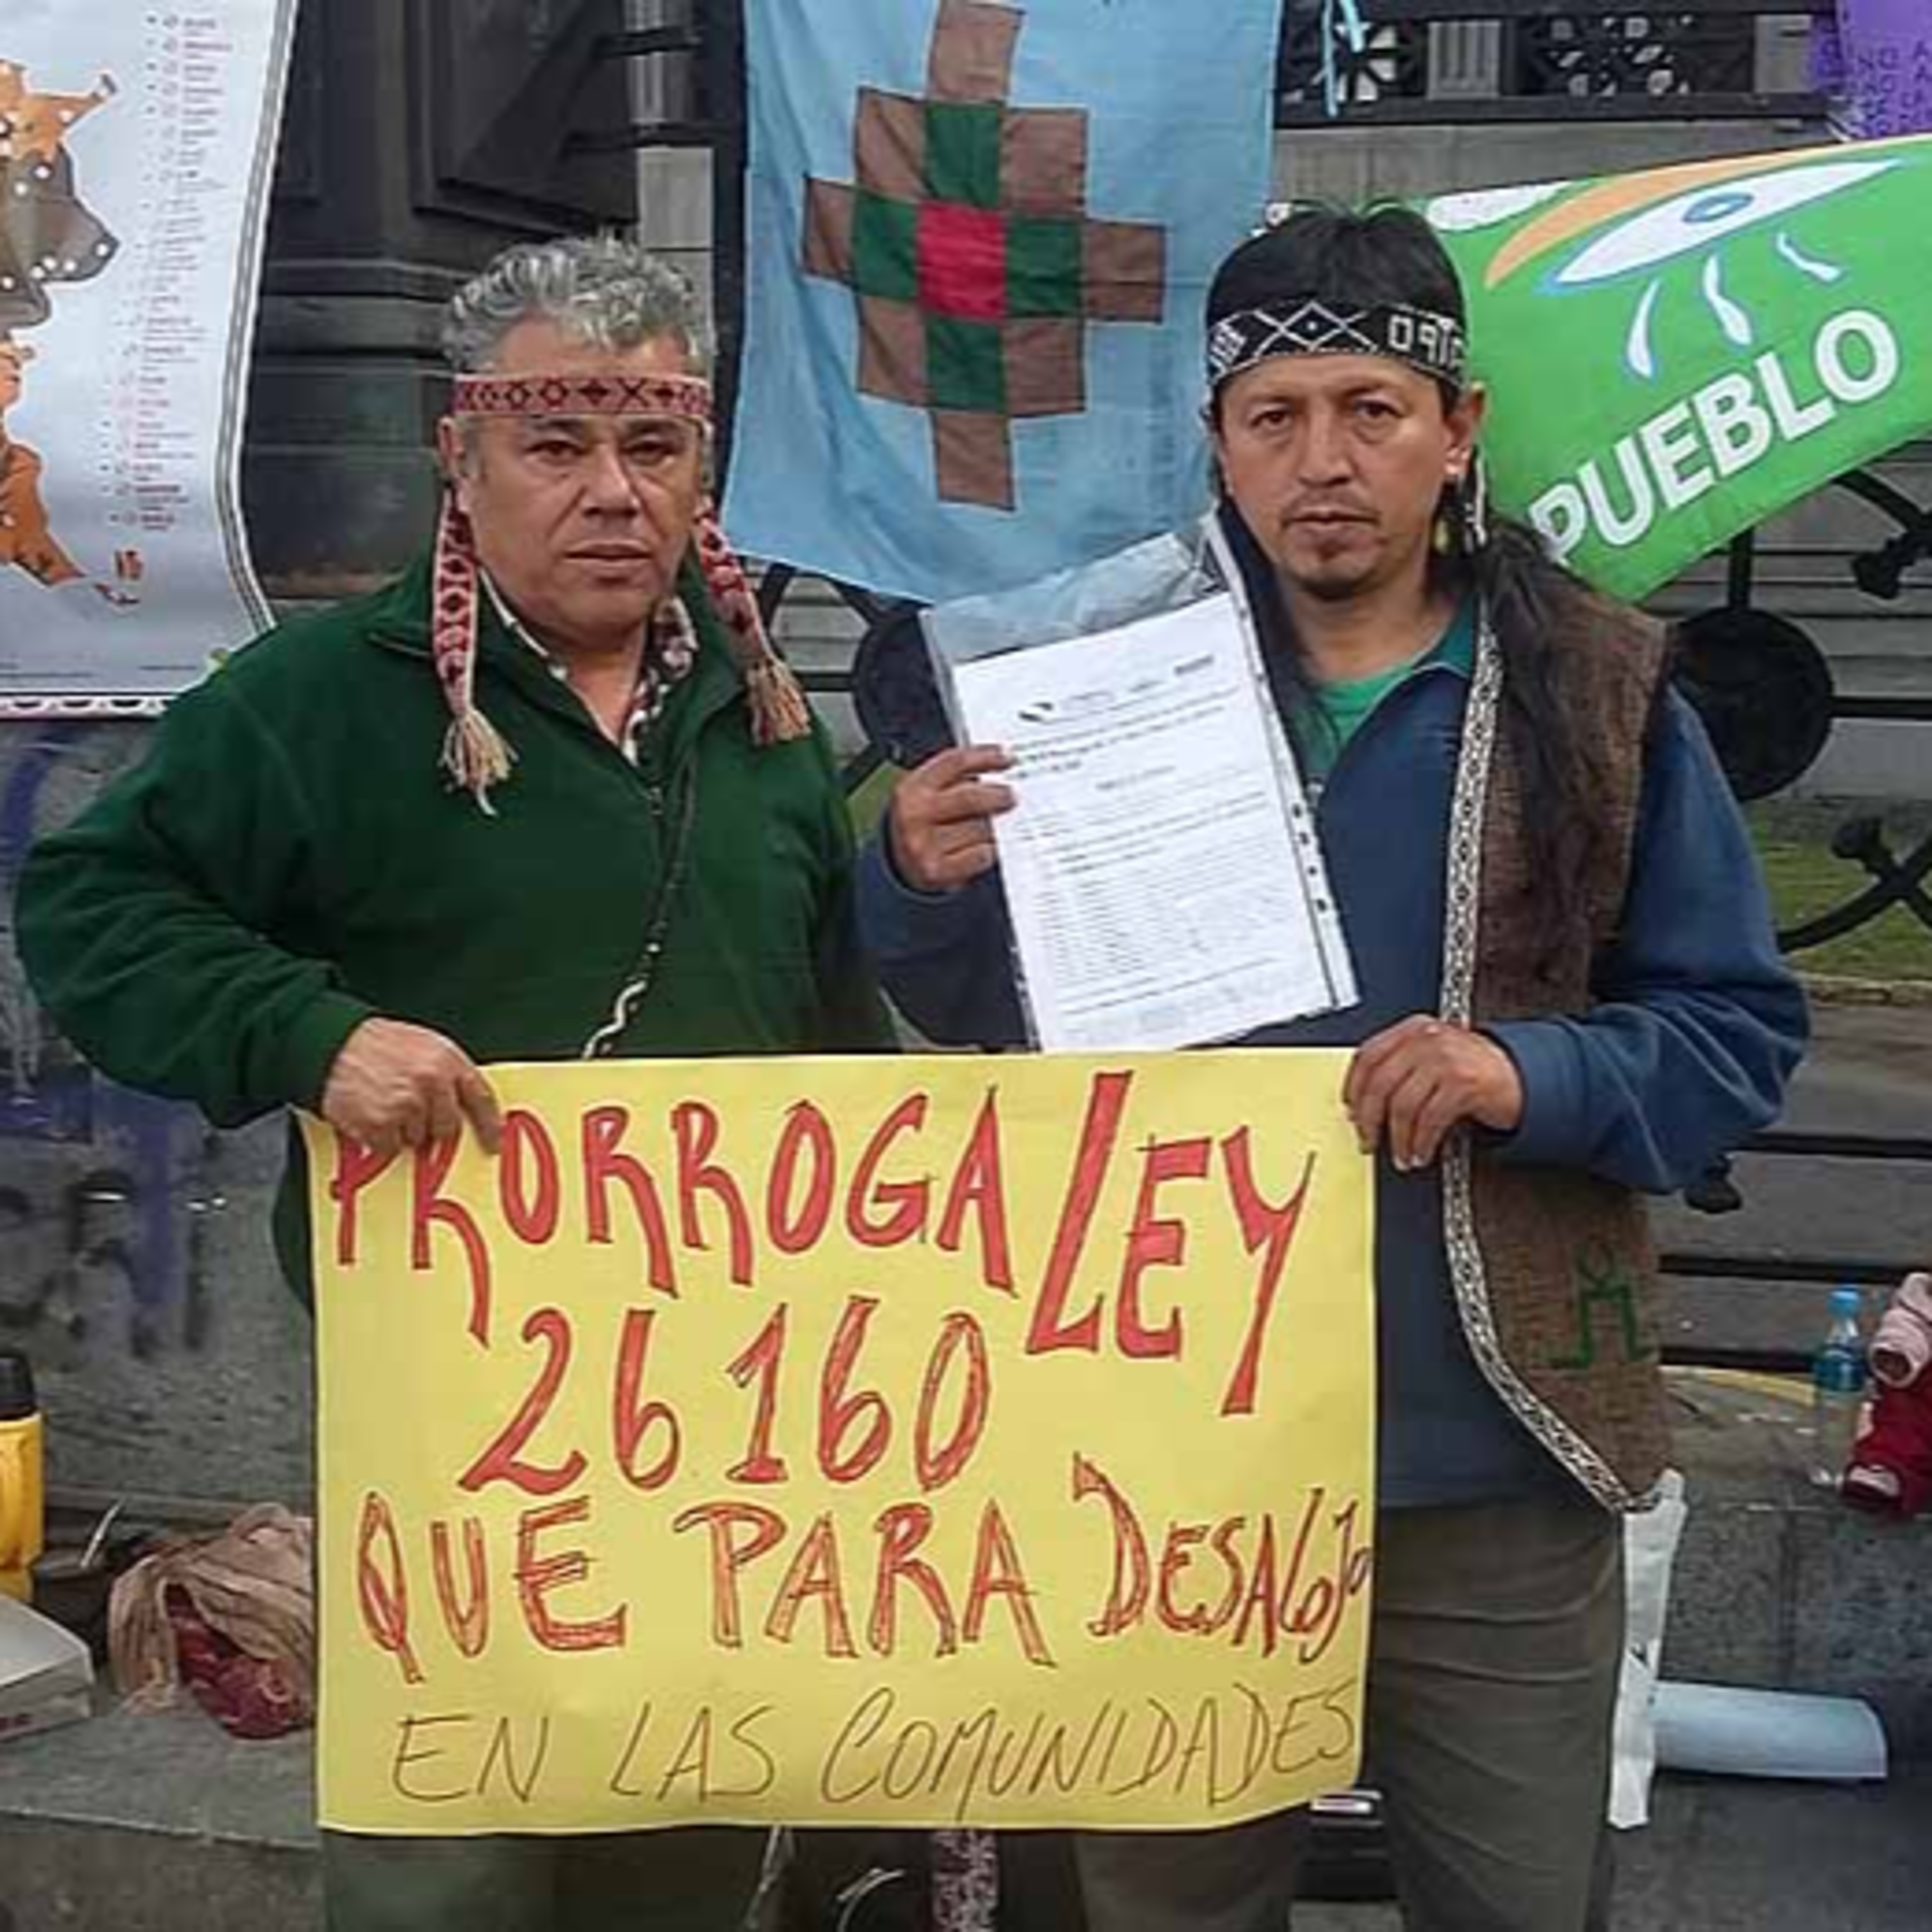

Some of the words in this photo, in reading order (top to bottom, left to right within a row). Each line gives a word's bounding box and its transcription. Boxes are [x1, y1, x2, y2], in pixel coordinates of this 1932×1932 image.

[1528, 309, 1899, 567] PUEBLO
[330, 1084, 1019, 1348] PRORROGA
[1025, 1070, 1316, 1416] LEY
[358, 1492, 627, 1683] QUE
[673, 1499, 1058, 1667] PARA
[393, 1714, 549, 1803] EN
[610, 1702, 775, 1802] LAS
[821, 1677, 1358, 1821] COMUNIDADES
